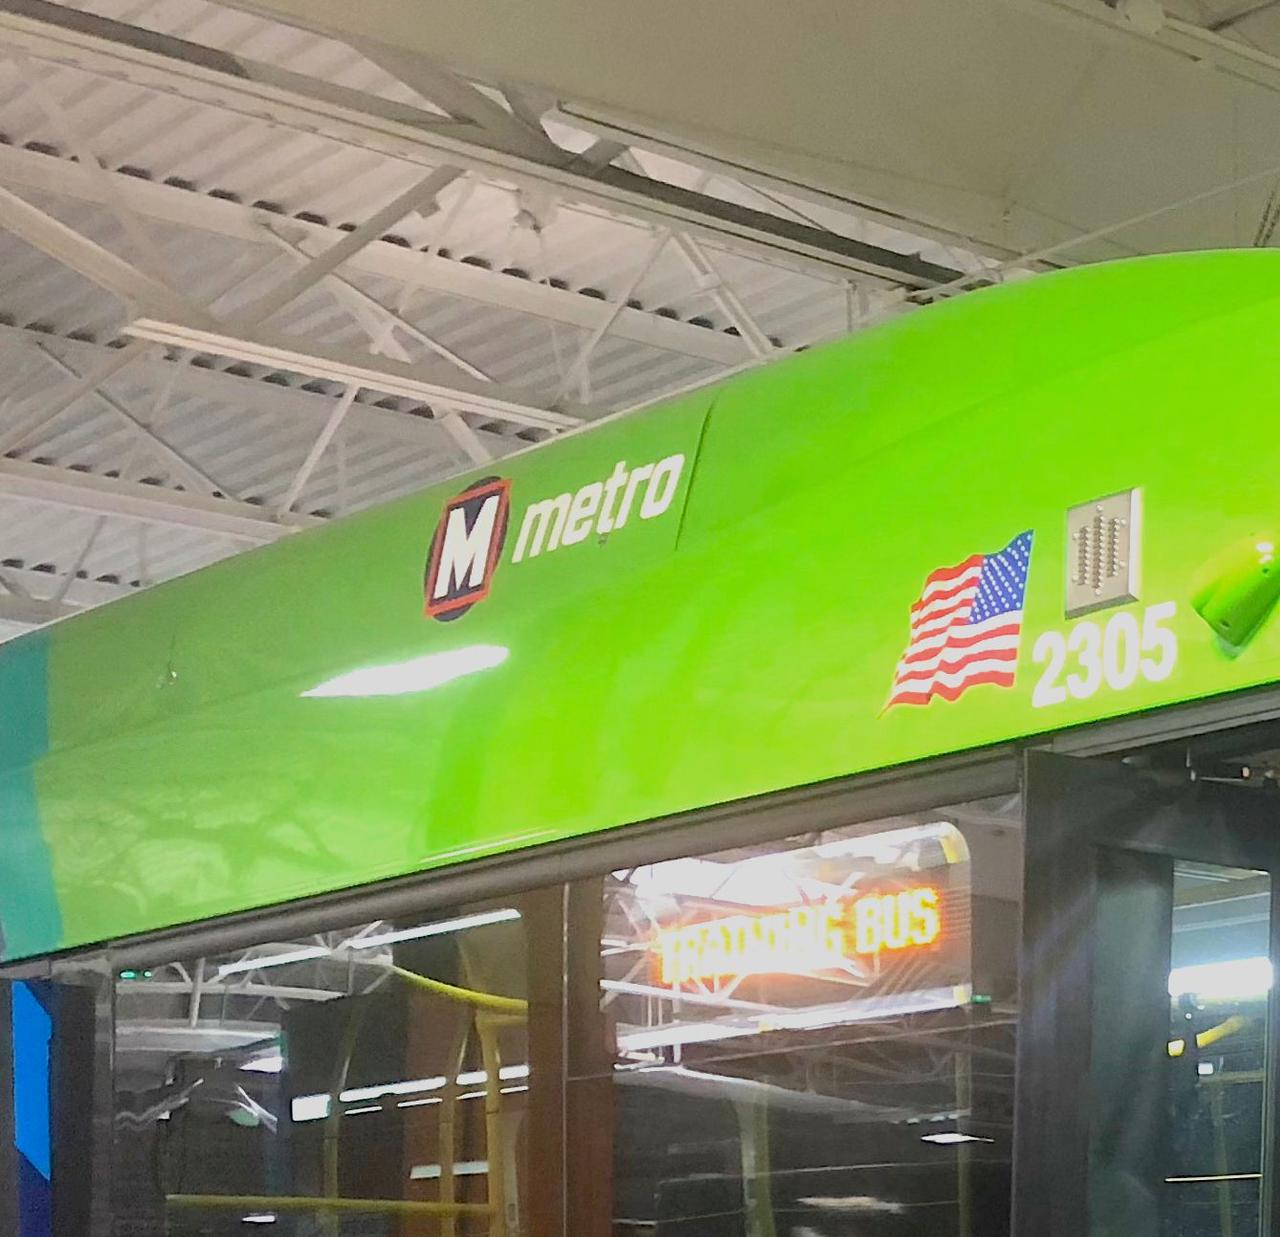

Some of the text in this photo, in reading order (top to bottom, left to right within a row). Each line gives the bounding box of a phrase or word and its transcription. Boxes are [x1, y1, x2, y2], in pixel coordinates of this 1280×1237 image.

[432, 453, 686, 598] M metro
[1031, 601, 1178, 709] 2305
[853, 887, 940, 955] BUS
